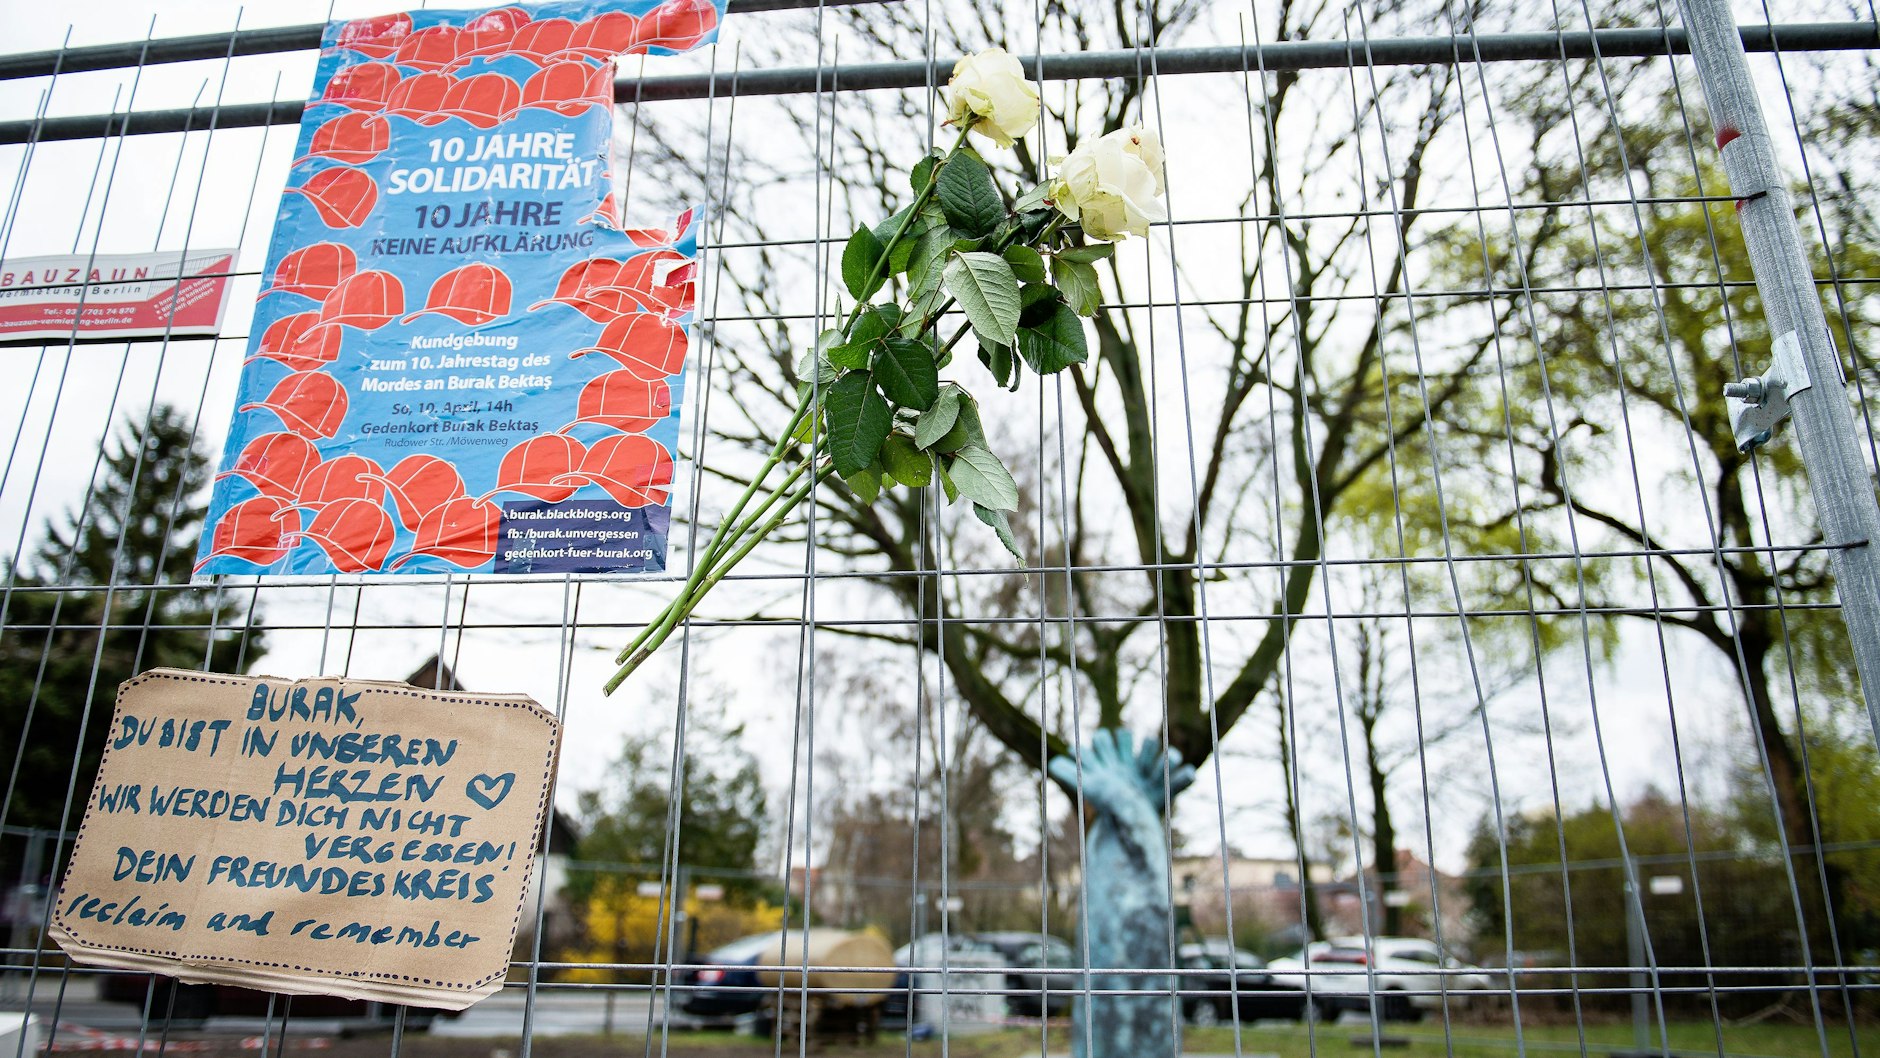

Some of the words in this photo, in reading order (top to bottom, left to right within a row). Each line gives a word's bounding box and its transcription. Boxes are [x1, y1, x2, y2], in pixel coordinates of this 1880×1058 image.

[428, 137, 465, 163] 10
[466, 132, 576, 161] JAHRE
[387, 157, 598, 194] SOLIDARITÄT
[415, 204, 450, 229] 10
[454, 201, 563, 228] JAHRE
[370, 237, 437, 256] KEINE
[440, 229, 594, 255] AUFKLÄRUNG
[92, 286, 141, 295] Berlin
[411, 332, 518, 350] Kundgebung
[369, 358, 406, 371] zum
[411, 356, 434, 370] 10.
[437, 354, 518, 371] Jahrestag
[522, 353, 551, 367] des
[360, 377, 422, 392] Mordes
[424, 379, 444, 391] an
[447, 374, 495, 390] Burak
[498, 374, 552, 390] Bektaş
[392, 403, 412, 415] So,
[418, 402, 438, 414] 10.
[442, 400, 481, 415] April,
[487, 400, 513, 412] 14h
[360, 422, 439, 434] Gedenkort
[442, 420, 484, 432] Burak
[488, 419, 539, 434] Bektaş
[384, 437, 427, 447] Rudower
[509, 509, 632, 522] burak.blackblogs.org
[504, 547, 653, 561] gedenkort-fuer-burak.org
[246, 683, 364, 729] BURAK,
[113, 715, 157, 750] DU
[158, 718, 232, 757] BIST
[241, 726, 279, 758] IN
[291, 731, 458, 768] UNSEREN
[273, 762, 445, 804] HERZEN
[99, 784, 142, 814] WIR
[149, 785, 271, 822] WERDEN
[275, 800, 349, 830] DICH
[359, 807, 472, 837] NICHT
[113, 846, 196, 884] DEIN
[305, 832, 517, 871] VERGESSEN!
[65, 893, 186, 931] reclaim
[206, 910, 275, 936] and
[290, 919, 480, 949] remember
